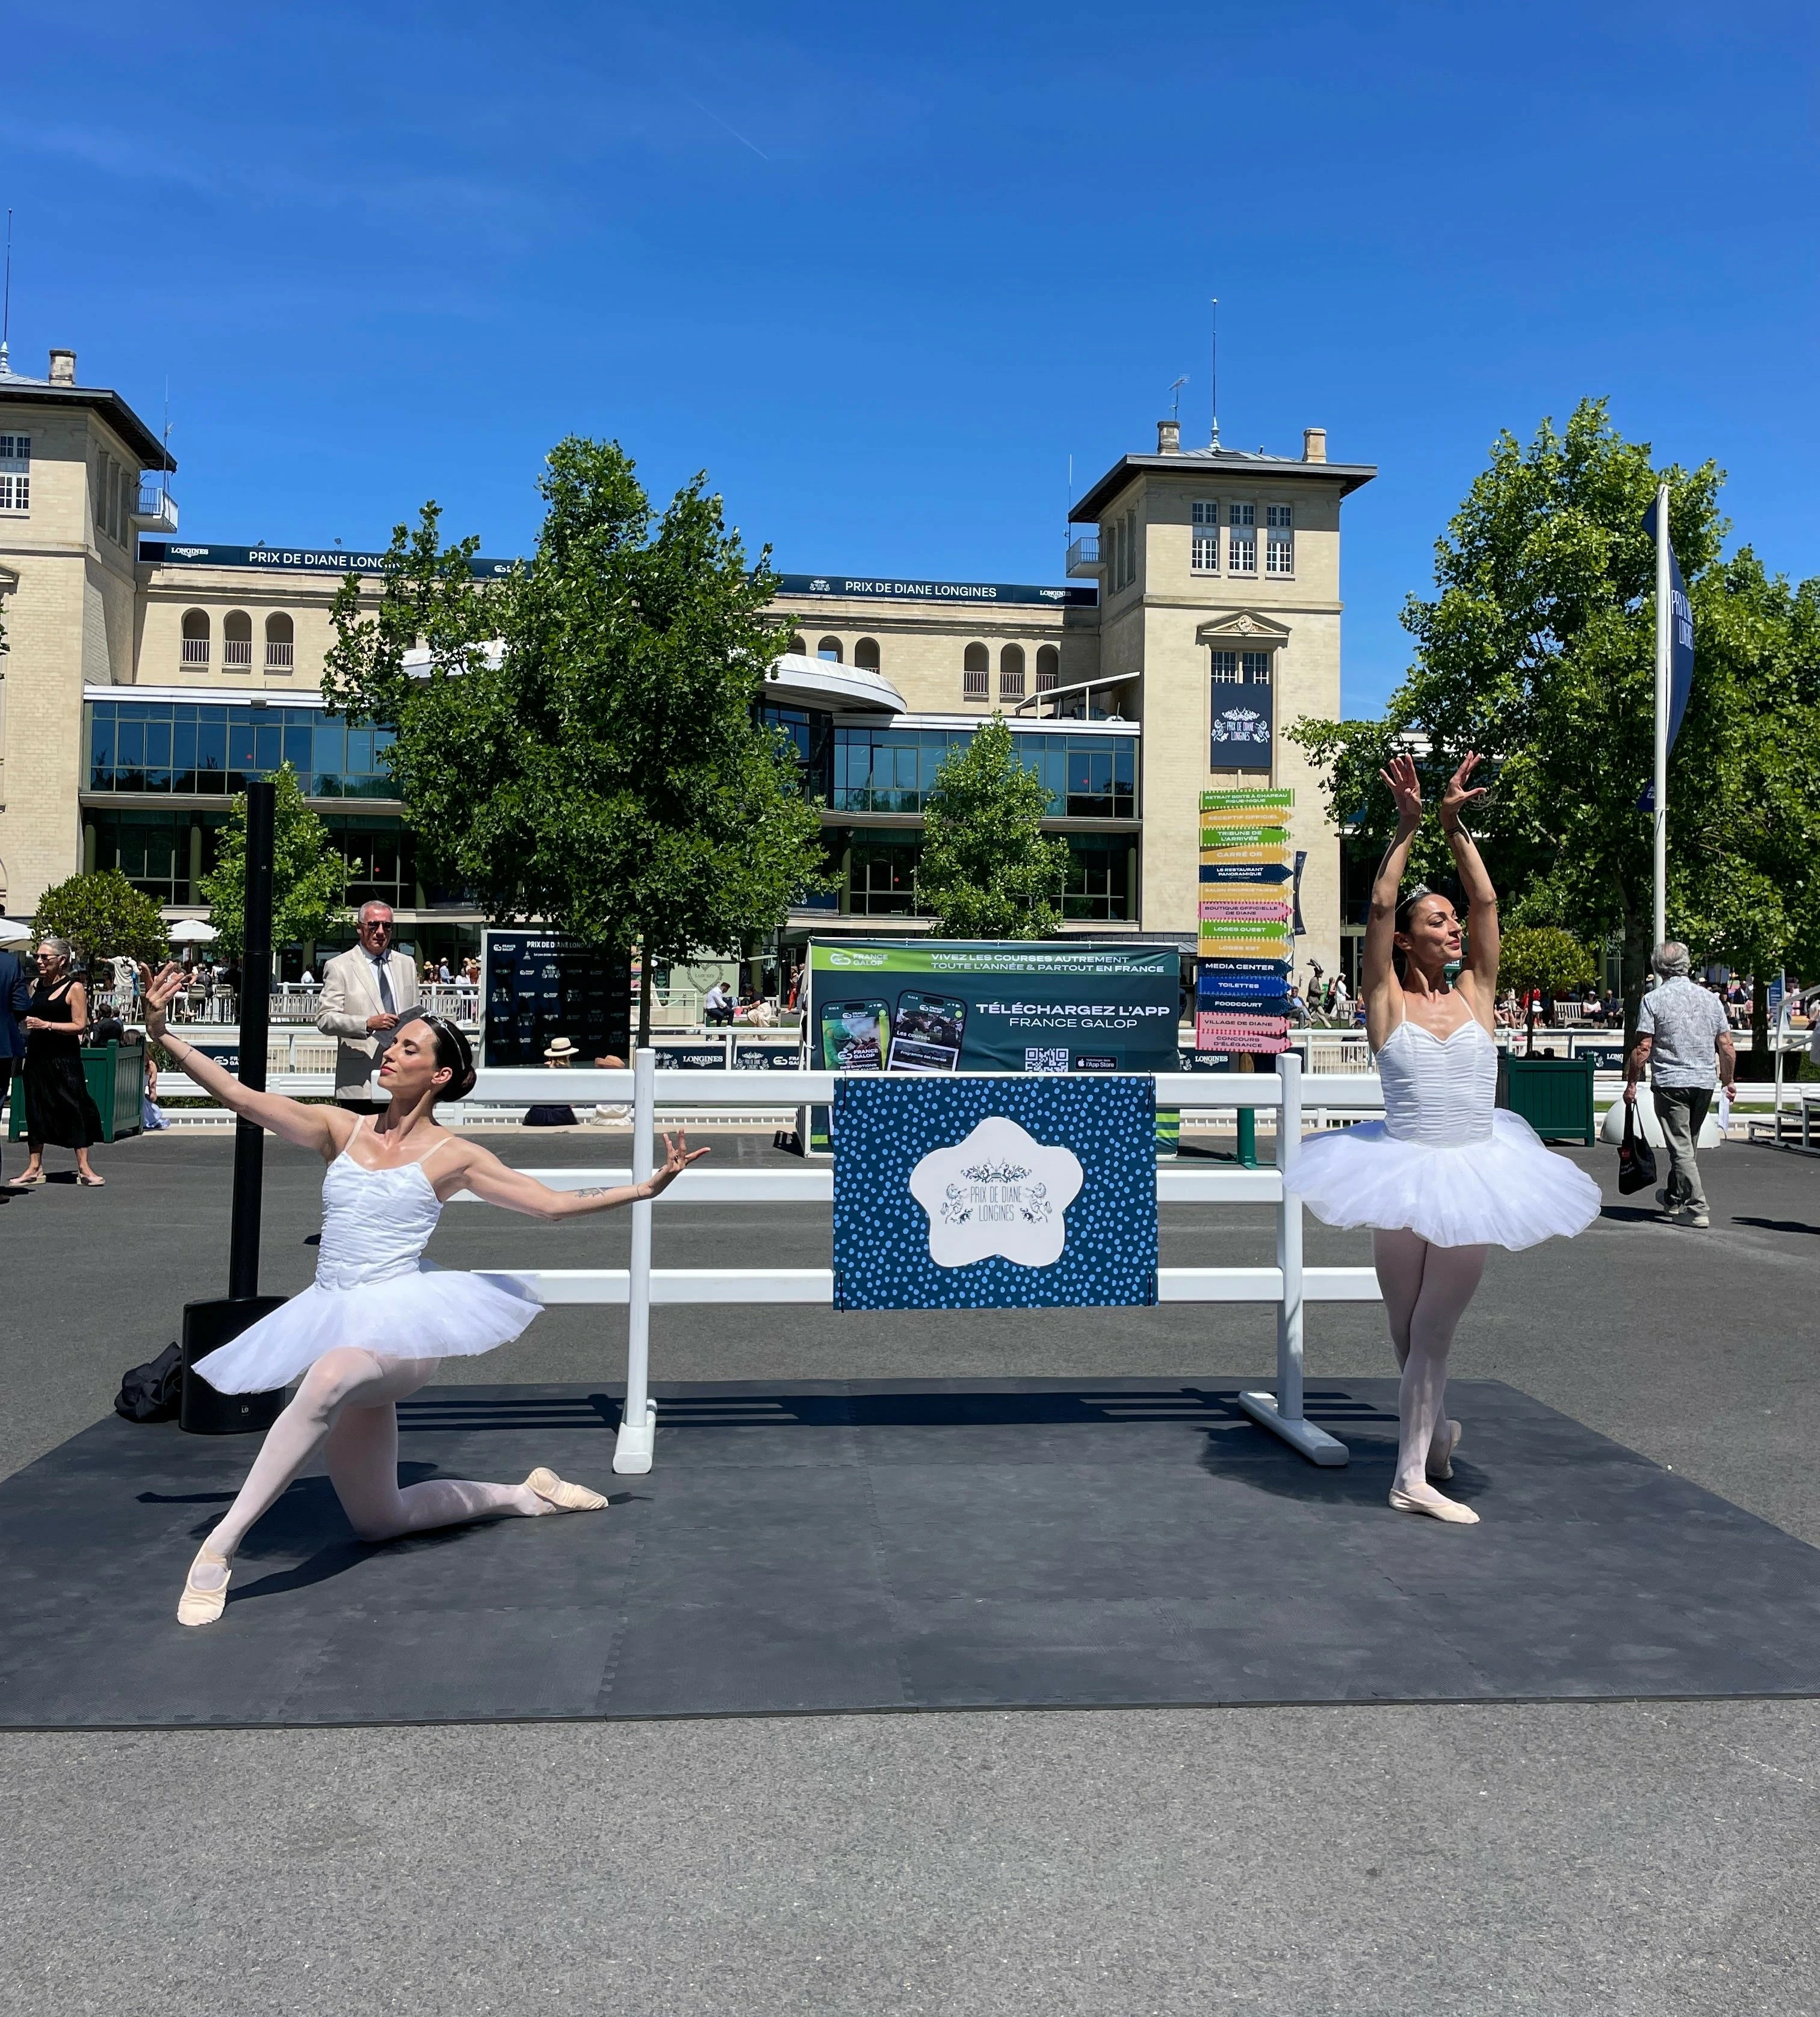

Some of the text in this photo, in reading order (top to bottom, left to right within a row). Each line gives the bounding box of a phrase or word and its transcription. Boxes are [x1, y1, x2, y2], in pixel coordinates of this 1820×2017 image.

[249, 551, 280, 564] PRIX
[283, 552, 302, 565] DE
[304, 554, 347, 566] DIANE
[845, 581, 997, 598] PRIX DE DIANE LONGINES
[976, 1002, 1116, 1016] TÉLÉCHARGEZ
[1009, 1017, 1138, 1029] FRANCE GALOP
[908, 1032, 930, 1041] courses
[970, 1185, 1023, 1203] PRIX DE DIANE
[979, 1204, 1015, 1222] LONGINES
